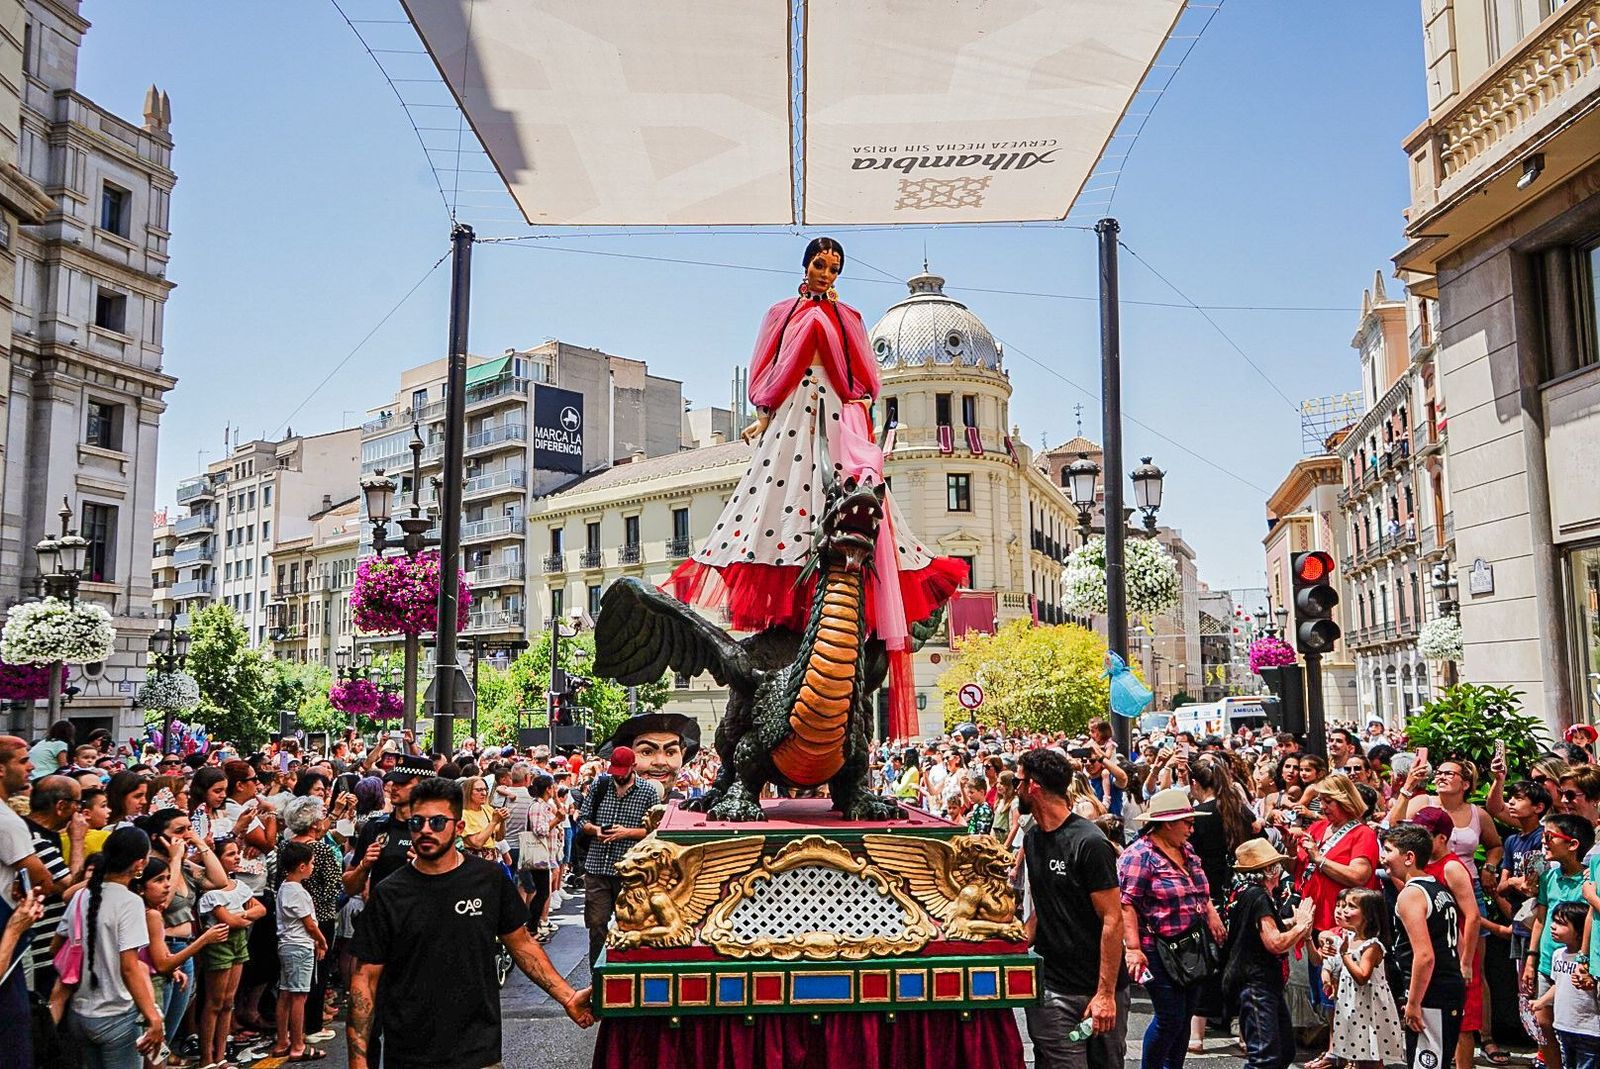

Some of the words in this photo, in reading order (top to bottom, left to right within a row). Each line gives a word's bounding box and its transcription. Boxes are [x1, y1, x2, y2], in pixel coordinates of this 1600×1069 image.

[853, 145, 897, 154] PRISA
[905, 144, 930, 152] SIN
[936, 143, 986, 151] HECHA
[992, 139, 1058, 149] CERVEZA
[851, 148, 1063, 174] Alhambra
[535, 426, 569, 443] MARCA
[570, 432, 582, 446] LA
[535, 438, 582, 456] DIFERENCIA
[1444, 906, 1458, 949] 13
